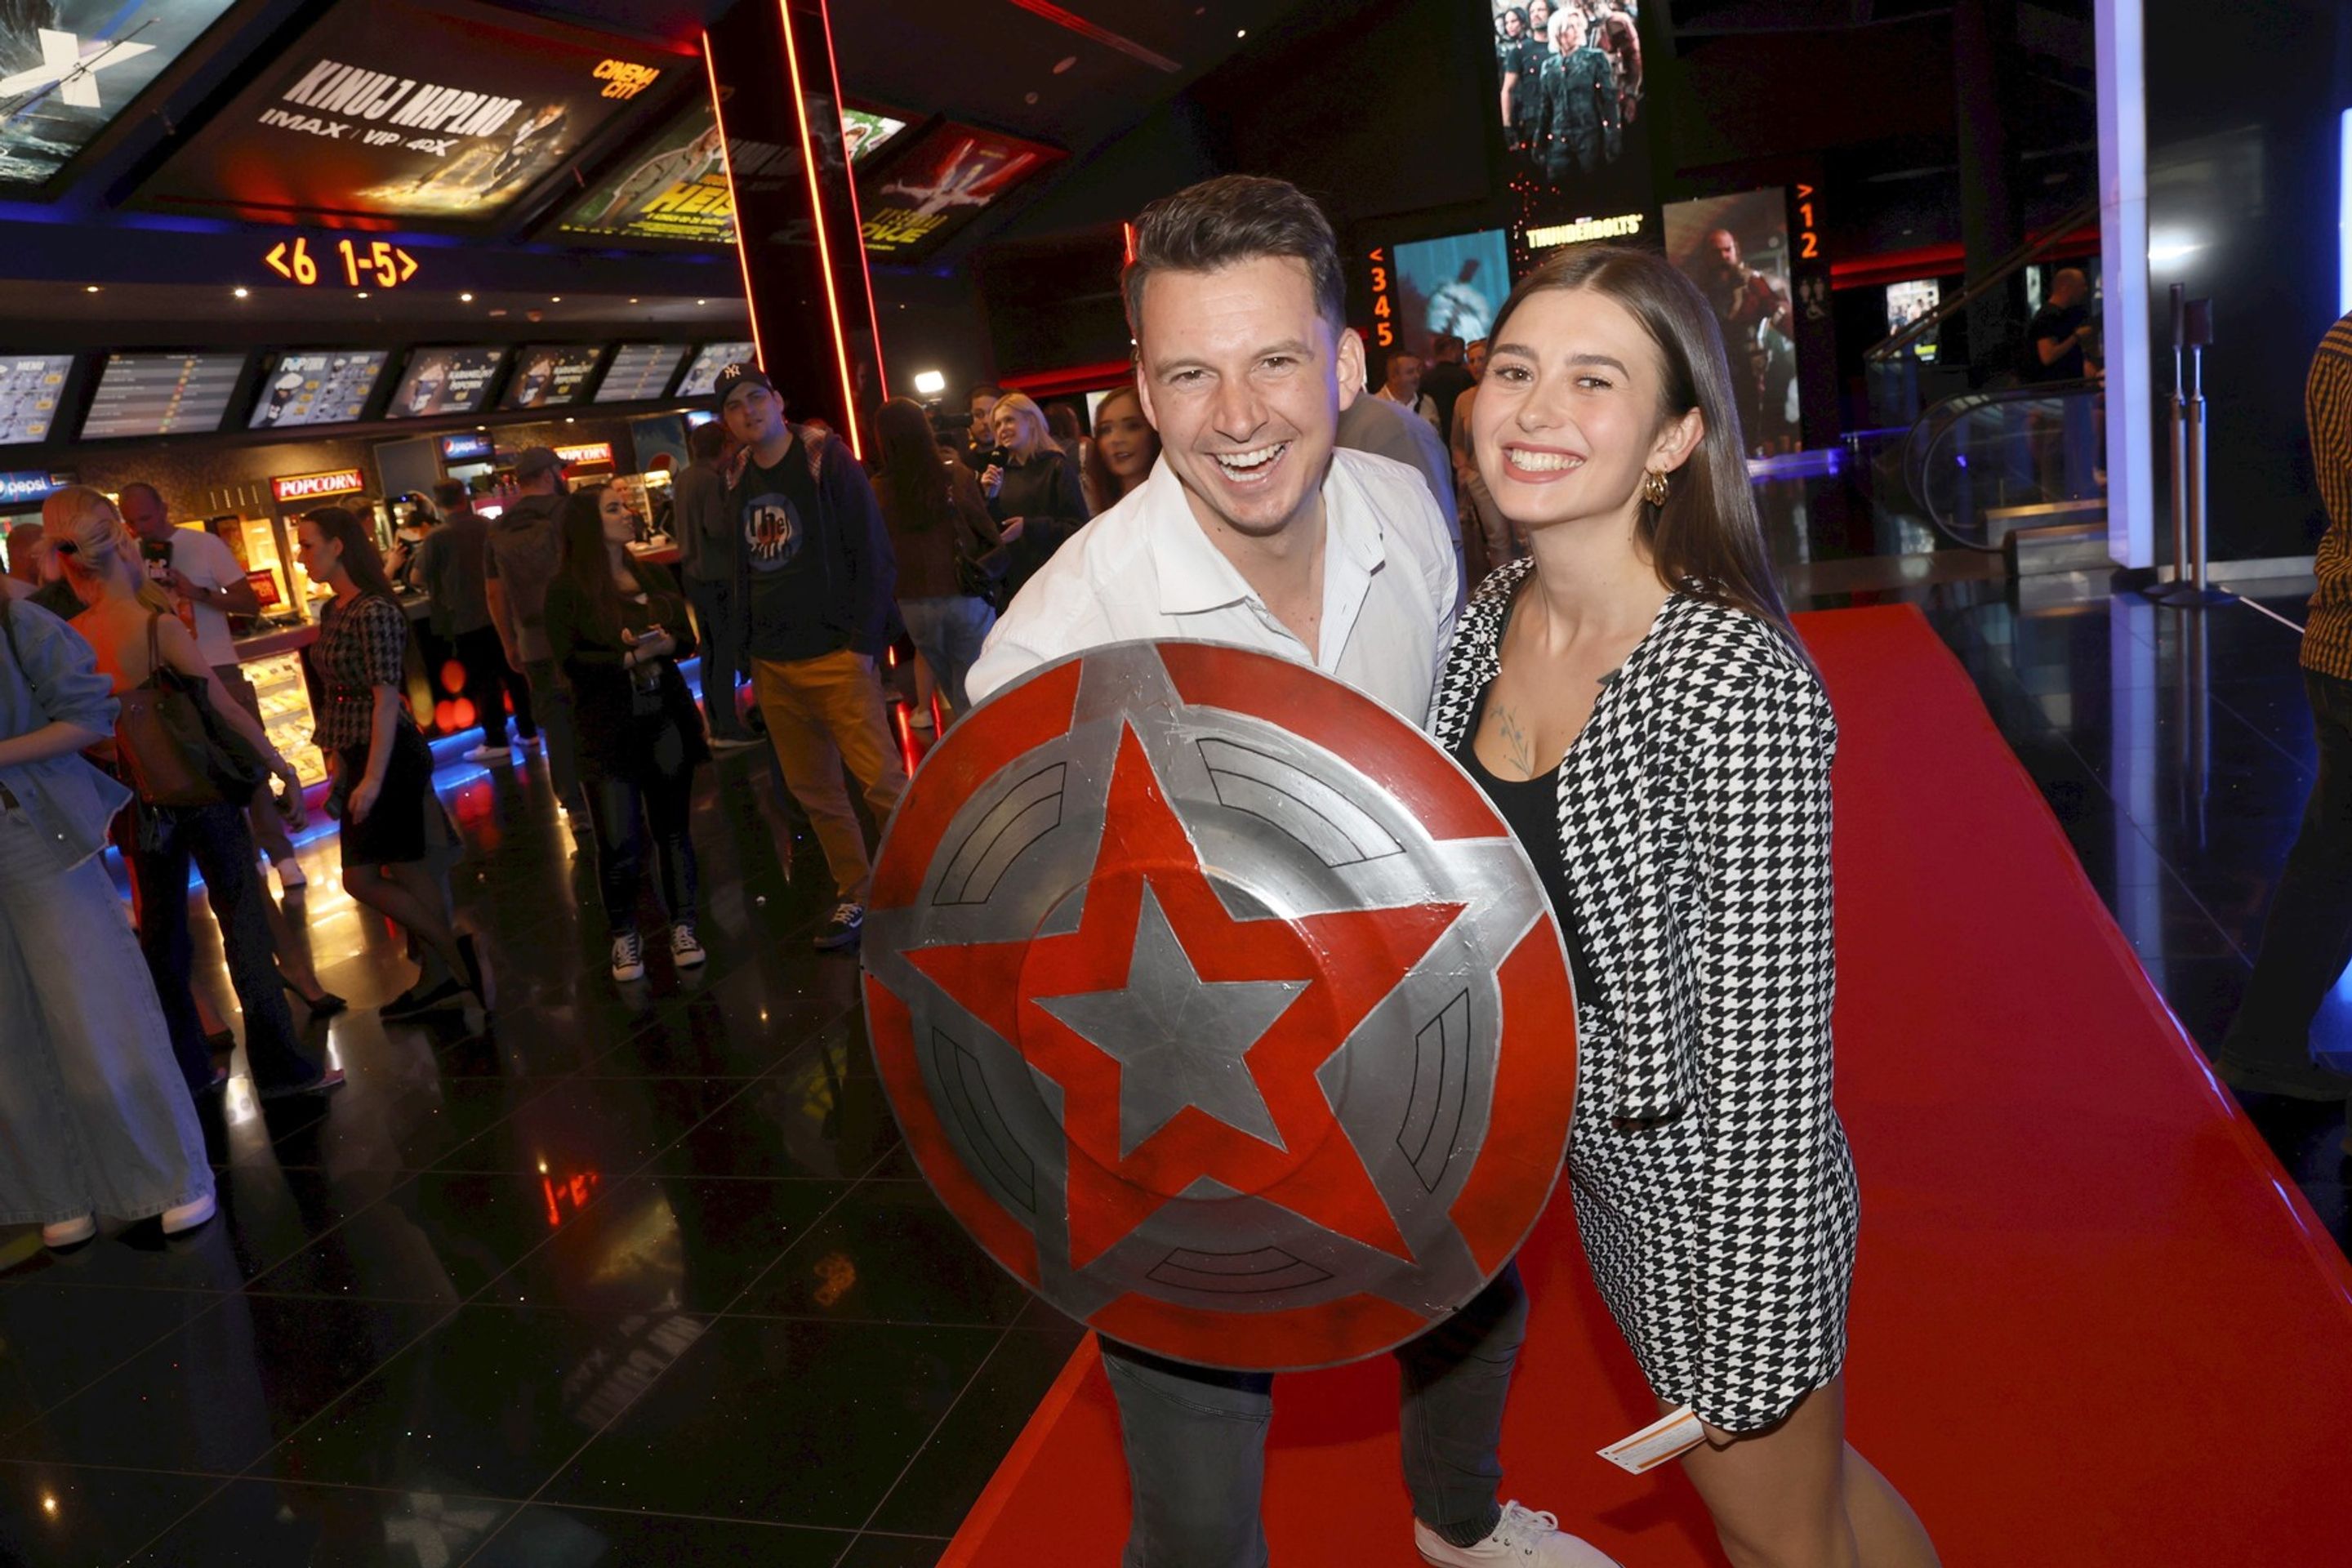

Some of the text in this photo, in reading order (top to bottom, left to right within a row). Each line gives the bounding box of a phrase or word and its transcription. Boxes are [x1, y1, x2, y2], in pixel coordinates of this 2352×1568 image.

[593, 59, 660, 86] CINEMA
[283, 59, 523, 137] KINUJ NAPLNO
[601, 81, 648, 100] CITY
[258, 109, 459, 157] IMAX VIP 4DX
[639, 181, 737, 216] HEIS
[1800, 203, 1812, 227] 1
[1801, 232, 1818, 258] 2
[1371, 267, 1387, 292] 3
[1374, 295, 1391, 318] 4
[1378, 322, 1393, 346] 5
[724, 364, 742, 380] NY
[8, 476, 48, 496] pepsi
[279, 473, 358, 497] POPCORN
